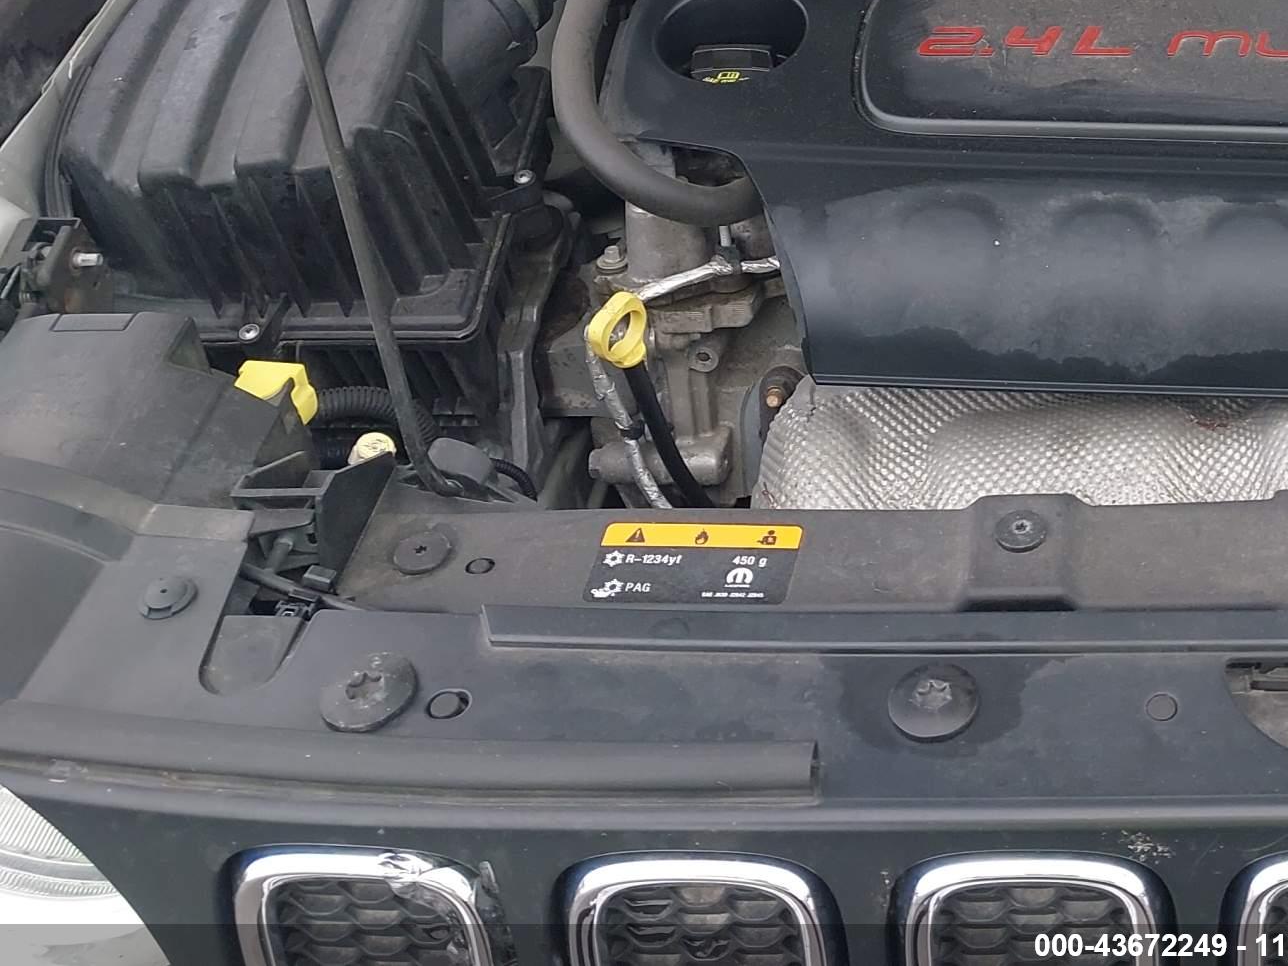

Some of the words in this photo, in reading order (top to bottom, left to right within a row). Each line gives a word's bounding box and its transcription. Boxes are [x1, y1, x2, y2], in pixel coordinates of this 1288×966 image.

[625, 553, 682, 566] R-1234yf
[732, 555, 755, 566] 450
[758, 556, 768, 568] g
[625, 582, 651, 593] PAG
